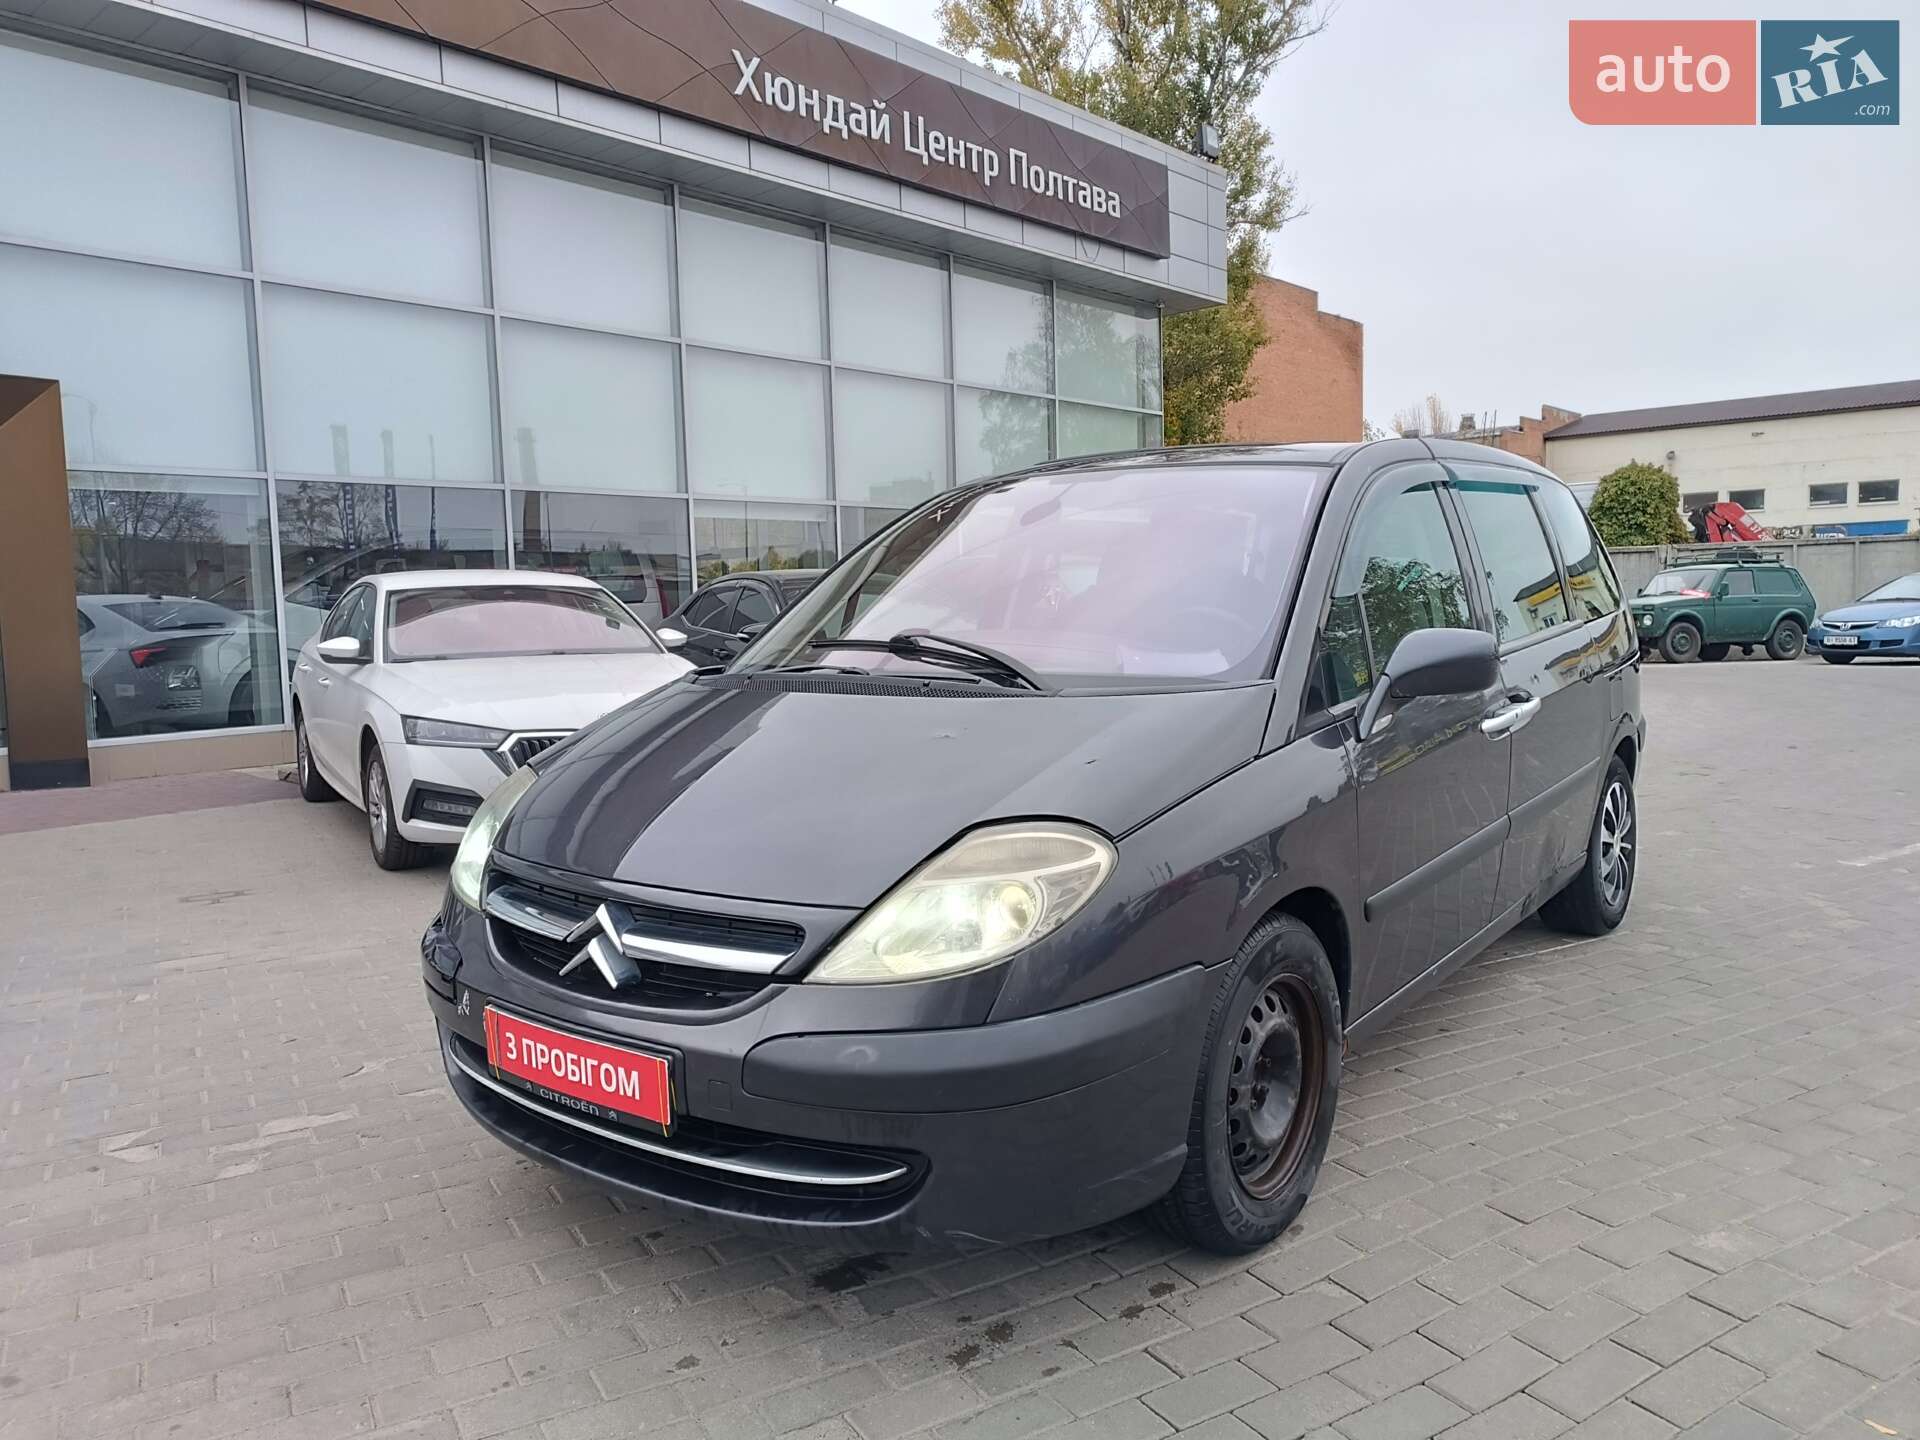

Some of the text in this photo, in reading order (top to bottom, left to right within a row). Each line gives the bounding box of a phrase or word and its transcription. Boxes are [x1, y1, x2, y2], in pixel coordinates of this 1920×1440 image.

[731, 48, 1122, 219] Хюндай Центр Полтава
[521, 1037, 641, 1101] ПРОБІГОМ
